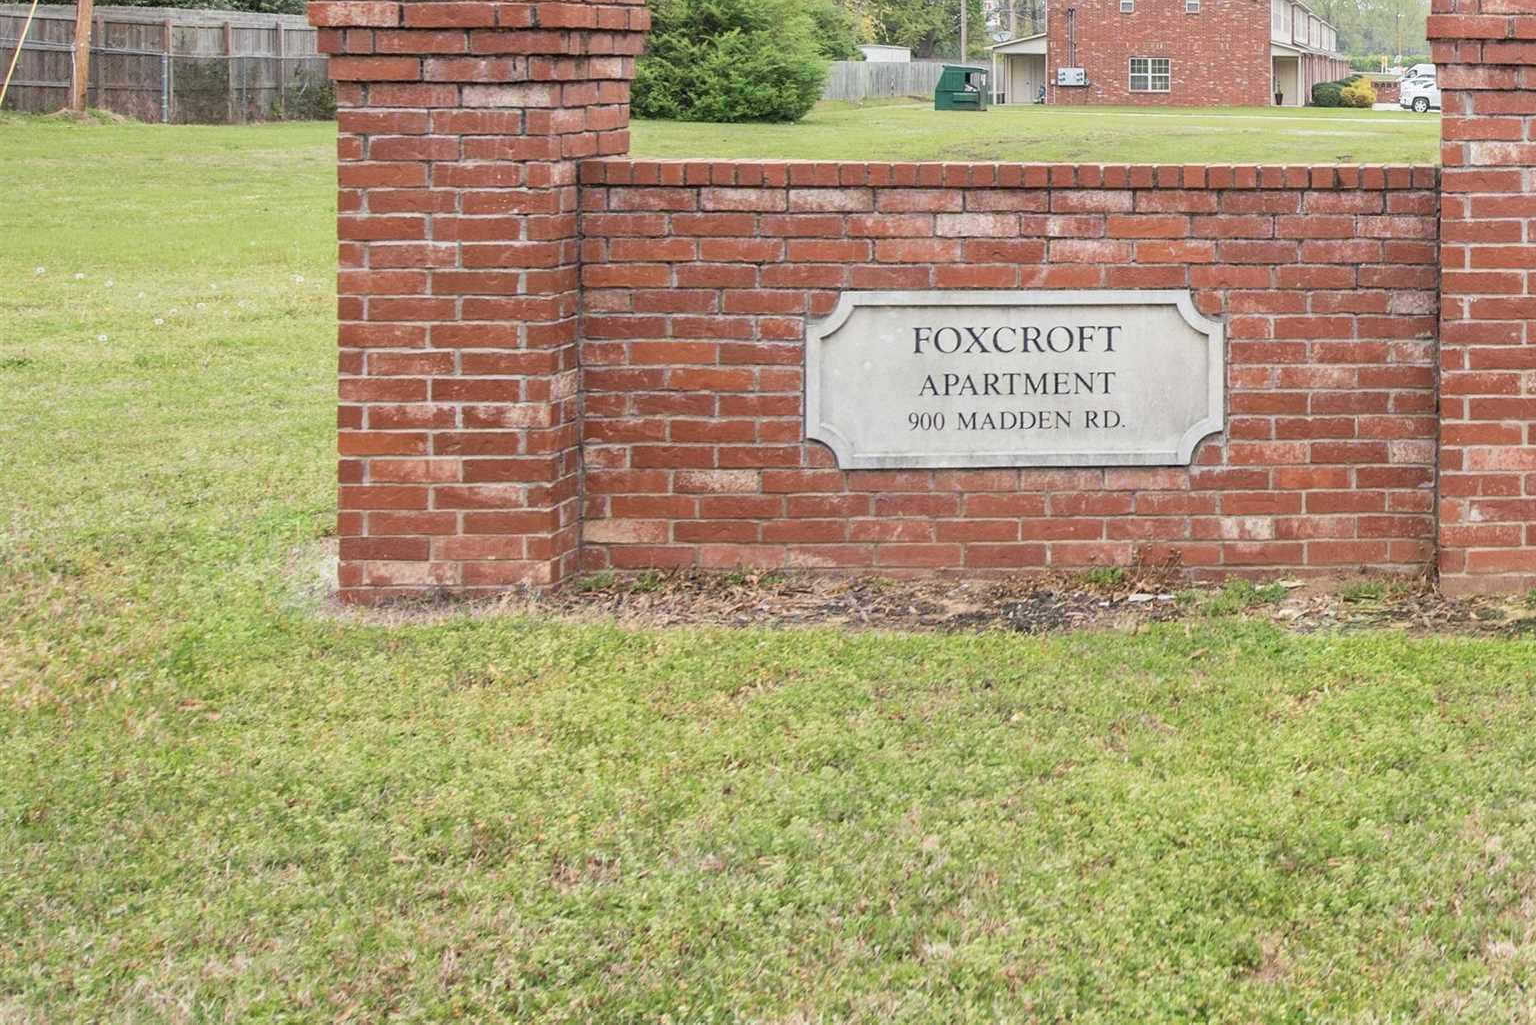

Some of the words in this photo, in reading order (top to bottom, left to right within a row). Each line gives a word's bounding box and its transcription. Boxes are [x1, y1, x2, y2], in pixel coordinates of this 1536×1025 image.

[912, 325, 1122, 354] FOXCROFT
[918, 371, 1116, 396] APARTMENT
[908, 411, 945, 431] 900
[957, 410, 1073, 430] MADDEN
[1085, 410, 1126, 429] RD.
